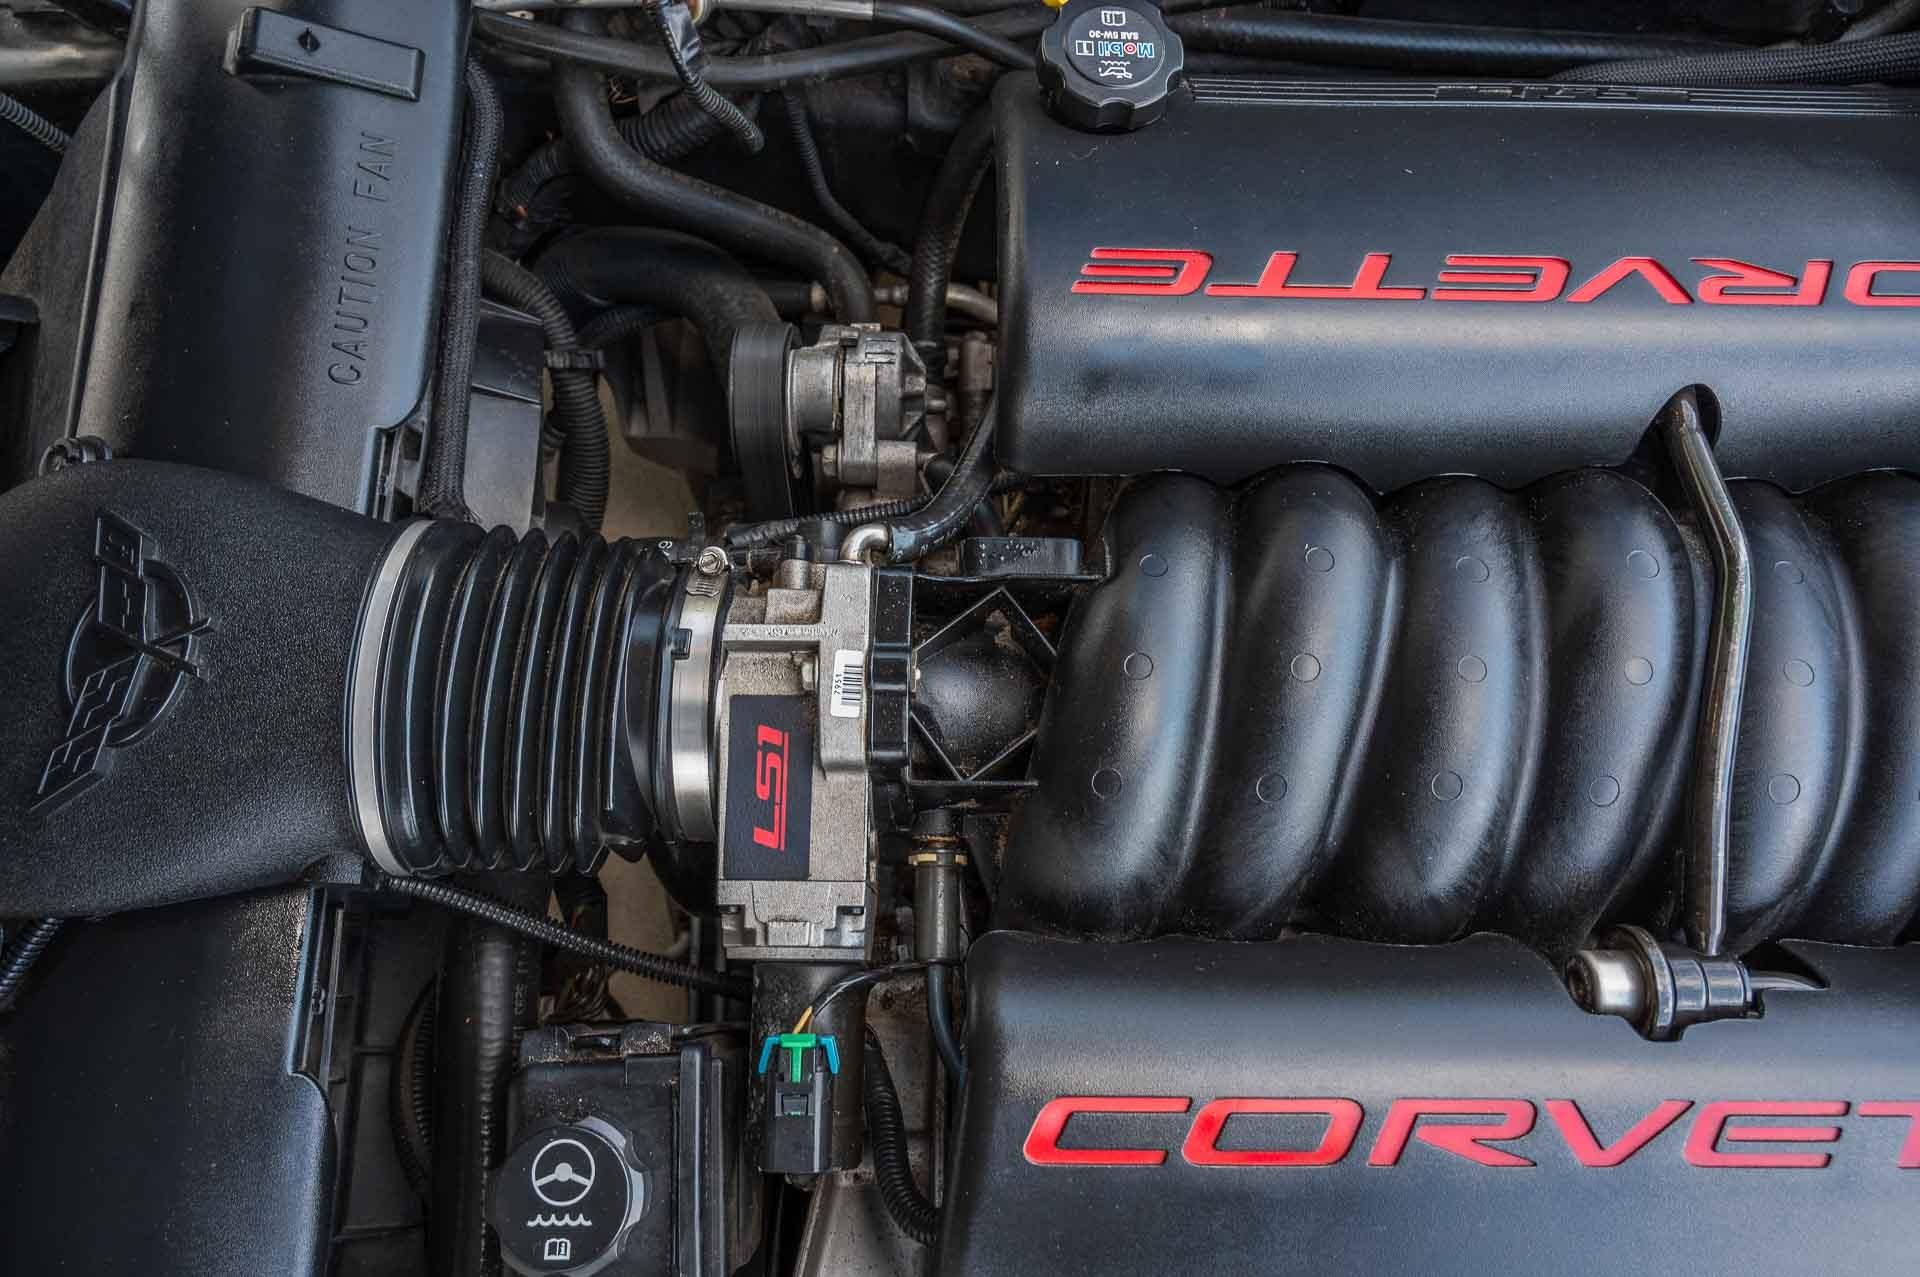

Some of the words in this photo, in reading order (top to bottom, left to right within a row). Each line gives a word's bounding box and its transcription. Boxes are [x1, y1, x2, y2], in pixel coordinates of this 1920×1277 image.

[1089, 30, 1118, 39] 5W-30
[1098, 41, 1154, 58] Mobil
[1121, 31, 1138, 40] SAE
[353, 131, 394, 202] FAN
[328, 226, 382, 386] CAUTION
[753, 724, 789, 850] LS1
